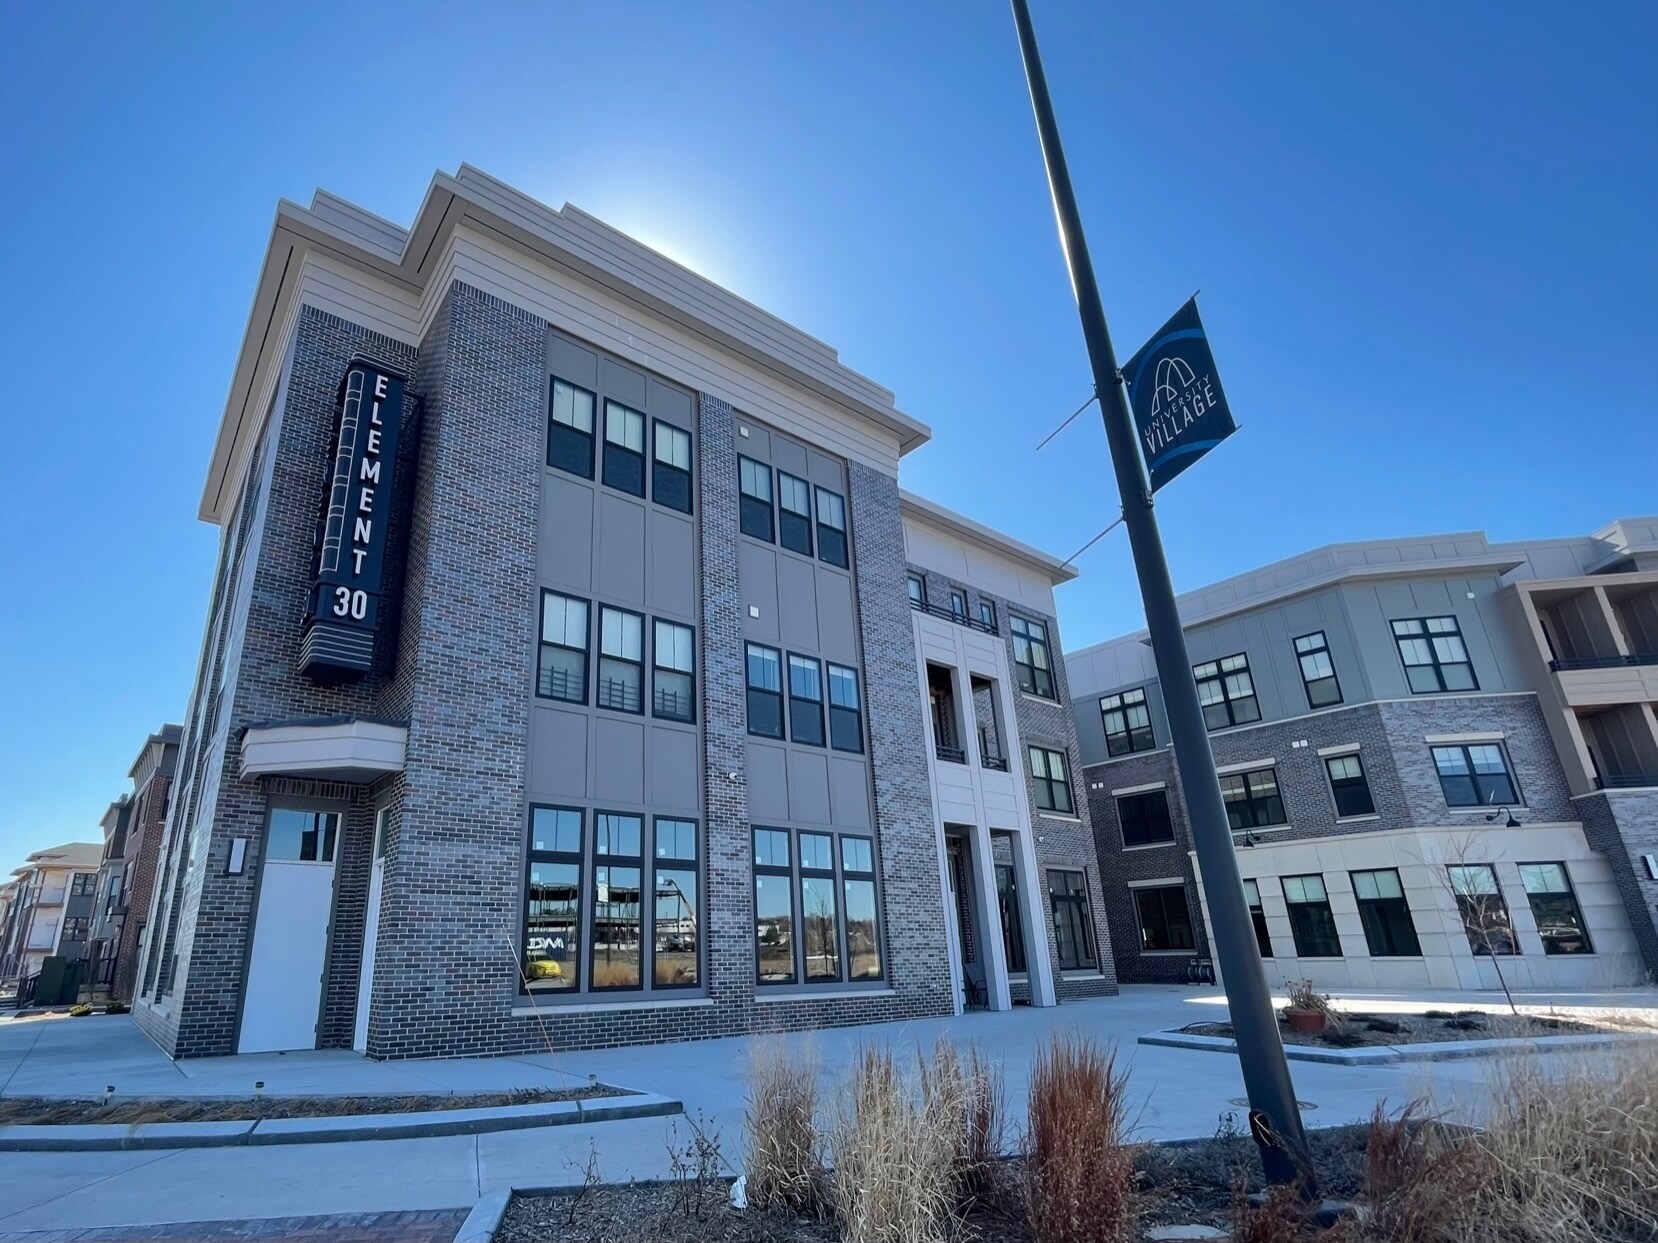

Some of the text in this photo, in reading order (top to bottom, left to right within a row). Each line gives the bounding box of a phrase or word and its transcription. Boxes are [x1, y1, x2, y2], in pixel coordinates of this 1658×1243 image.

[1144, 374, 1210, 436] UNIVERSITY
[1146, 384, 1217, 454] VILLAGE
[353, 374, 389, 575] ELEMENT
[333, 586, 368, 620] 30
